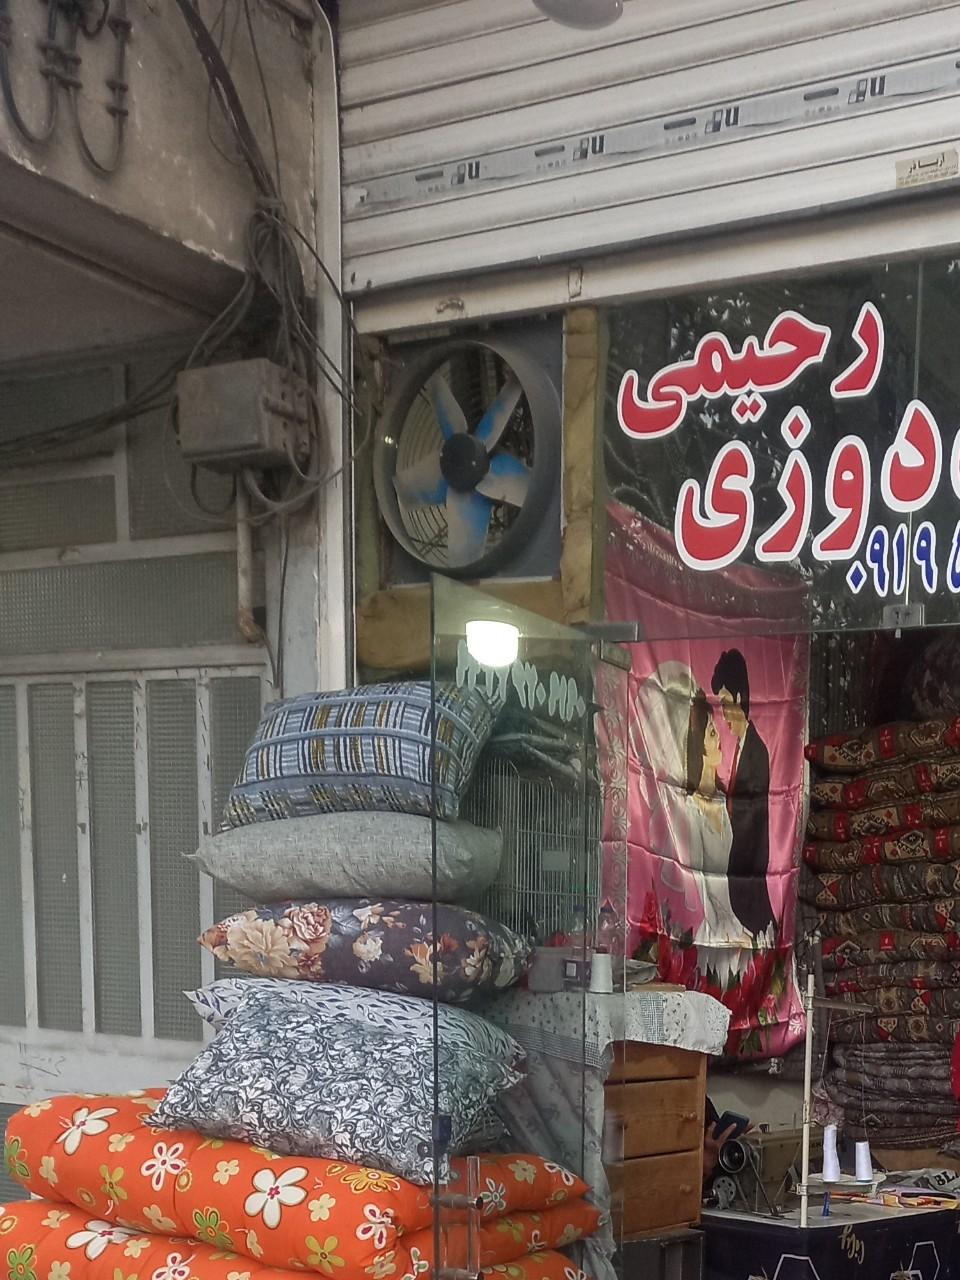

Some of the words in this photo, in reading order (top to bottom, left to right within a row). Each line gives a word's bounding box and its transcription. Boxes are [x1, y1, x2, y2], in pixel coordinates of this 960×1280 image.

[617, 301, 885, 440] رحیمی
[674, 397, 943, 572] دوزی
[846, 524, 938, 597] ۰۹۱۹
